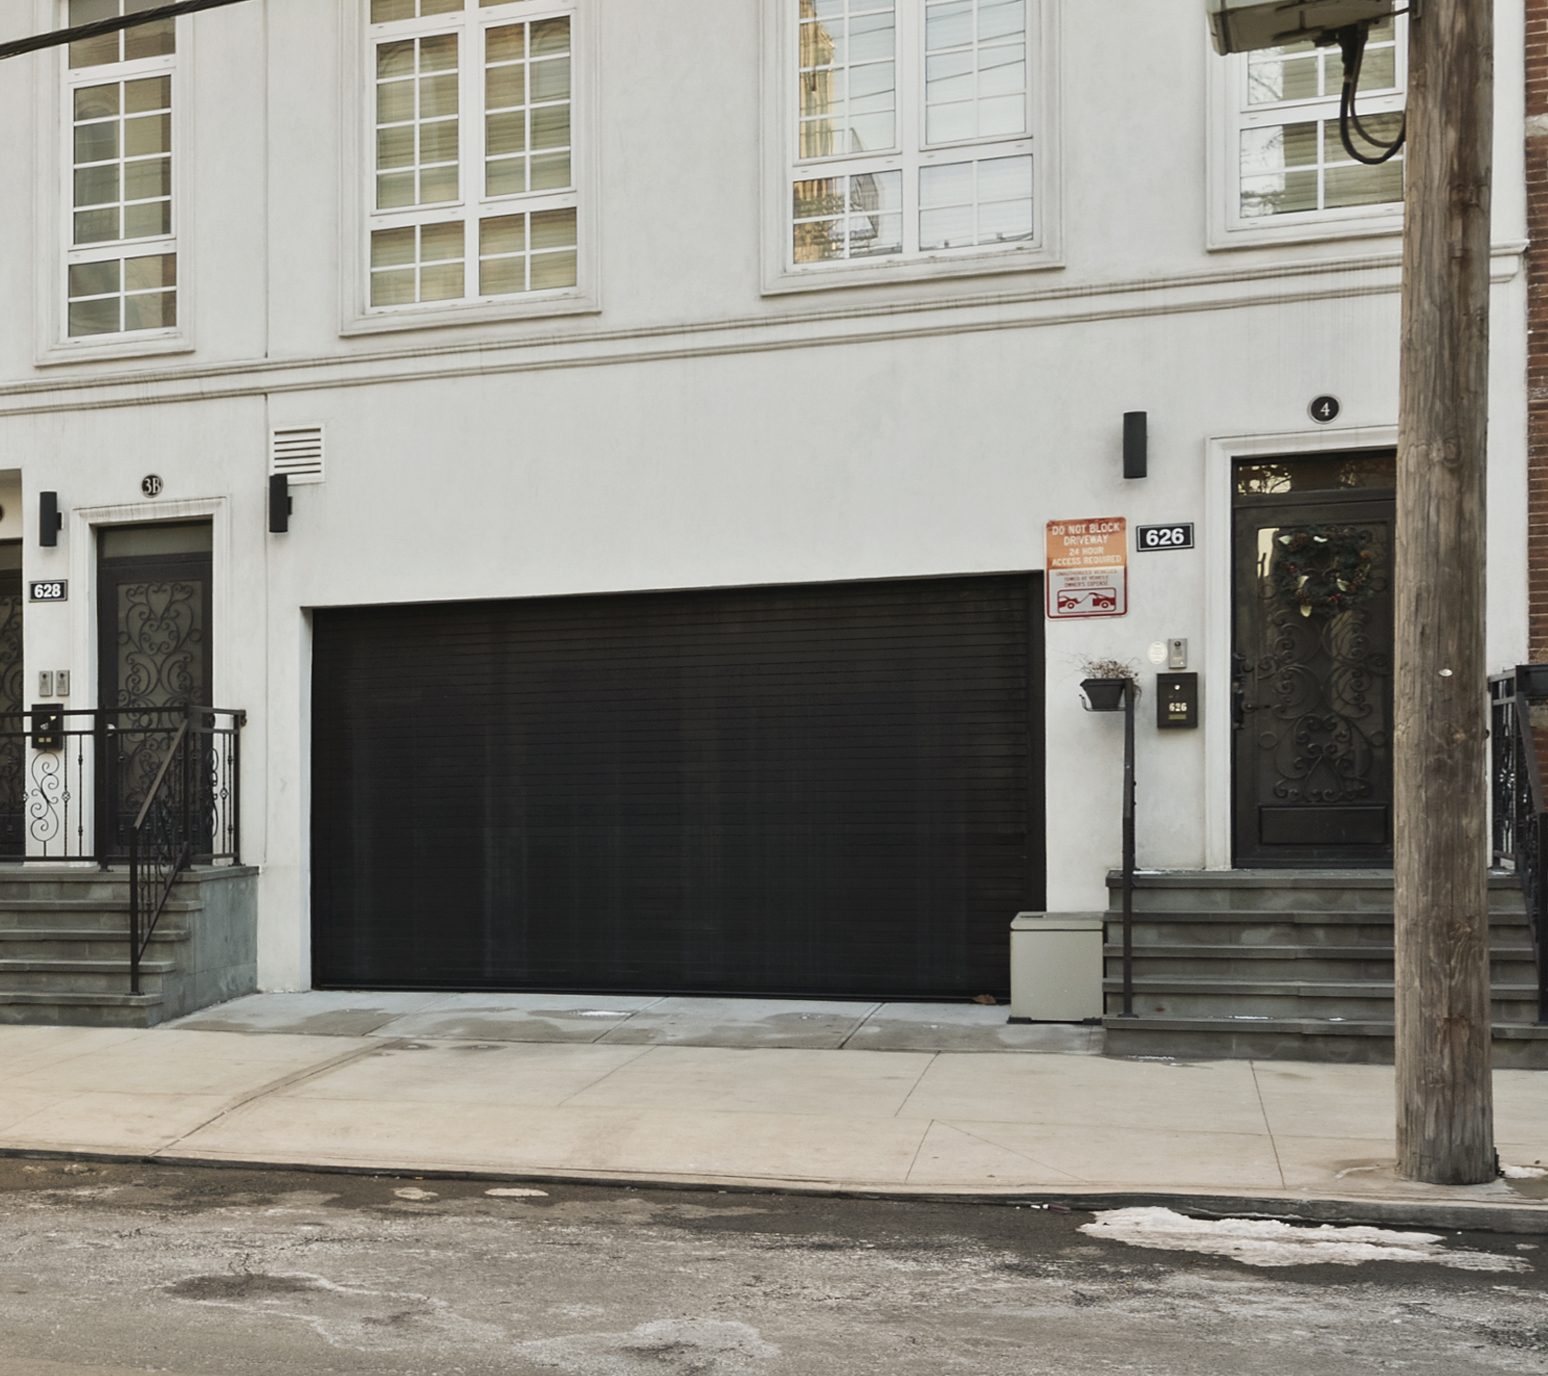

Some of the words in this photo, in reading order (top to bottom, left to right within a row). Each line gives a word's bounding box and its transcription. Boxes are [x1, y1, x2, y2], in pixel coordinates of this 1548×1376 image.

[1320, 402, 1331, 417] 4
[144, 477, 161, 494] 3B
[1052, 525, 1065, 536] DO
[1068, 524, 1086, 535] NOT
[1089, 522, 1120, 534] BLOCK
[1064, 534, 1109, 546] DRIVEWAY
[1146, 528, 1185, 546] 626
[1069, 548, 1079, 556] 24
[1082, 547, 1104, 555] HOUR
[1052, 557, 1081, 566] ACCESS
[1084, 555, 1122, 564] REQUIRED
[34, 584, 61, 598] 628
[1169, 702, 1187, 712] 626
